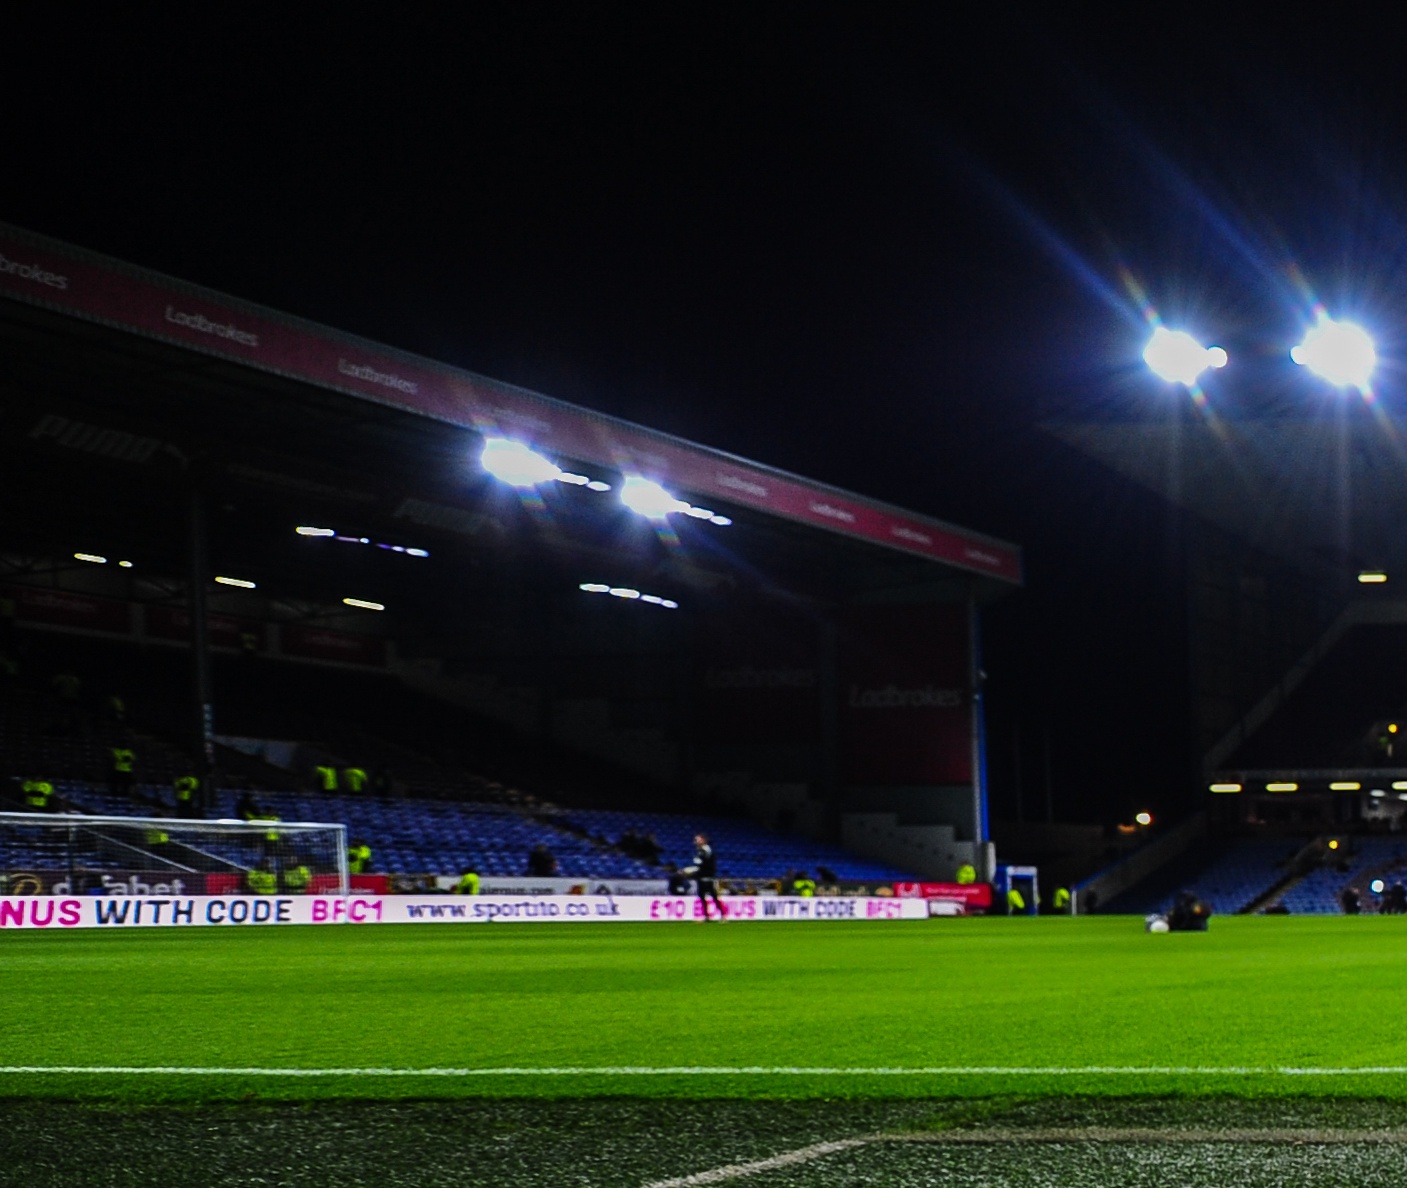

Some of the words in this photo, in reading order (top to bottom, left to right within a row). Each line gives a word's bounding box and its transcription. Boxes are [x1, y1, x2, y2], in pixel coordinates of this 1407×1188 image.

[165, 305, 259, 347] Ladbrokes
[0, 900, 81, 926] NUS
[95, 900, 194, 924] WITH
[206, 899, 293, 923] CODE
[312, 899, 383, 922] BFC1
[763, 900, 812, 918] WITH
[816, 900, 857, 918] CODE
